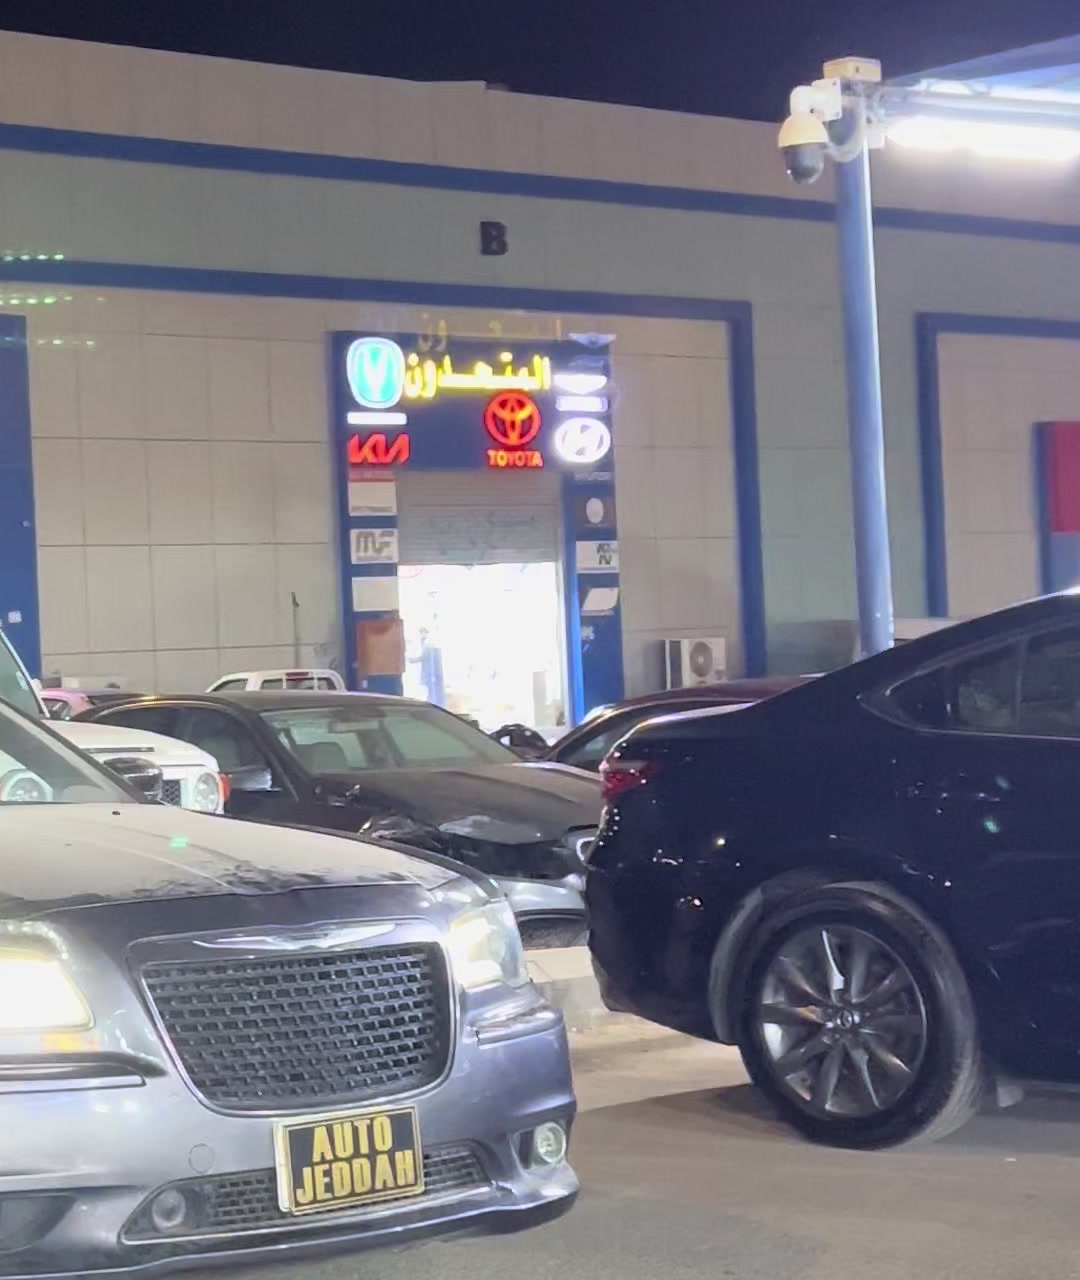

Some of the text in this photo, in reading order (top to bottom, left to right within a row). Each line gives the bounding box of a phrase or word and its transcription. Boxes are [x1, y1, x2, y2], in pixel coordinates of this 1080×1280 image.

[480, 221, 508, 256] B
[347, 434, 410, 464] KIA
[487, 449, 544, 467] TOYOTA
[312, 1116, 393, 1163] AUTO
[296, 1150, 416, 1204] JEDDAH
